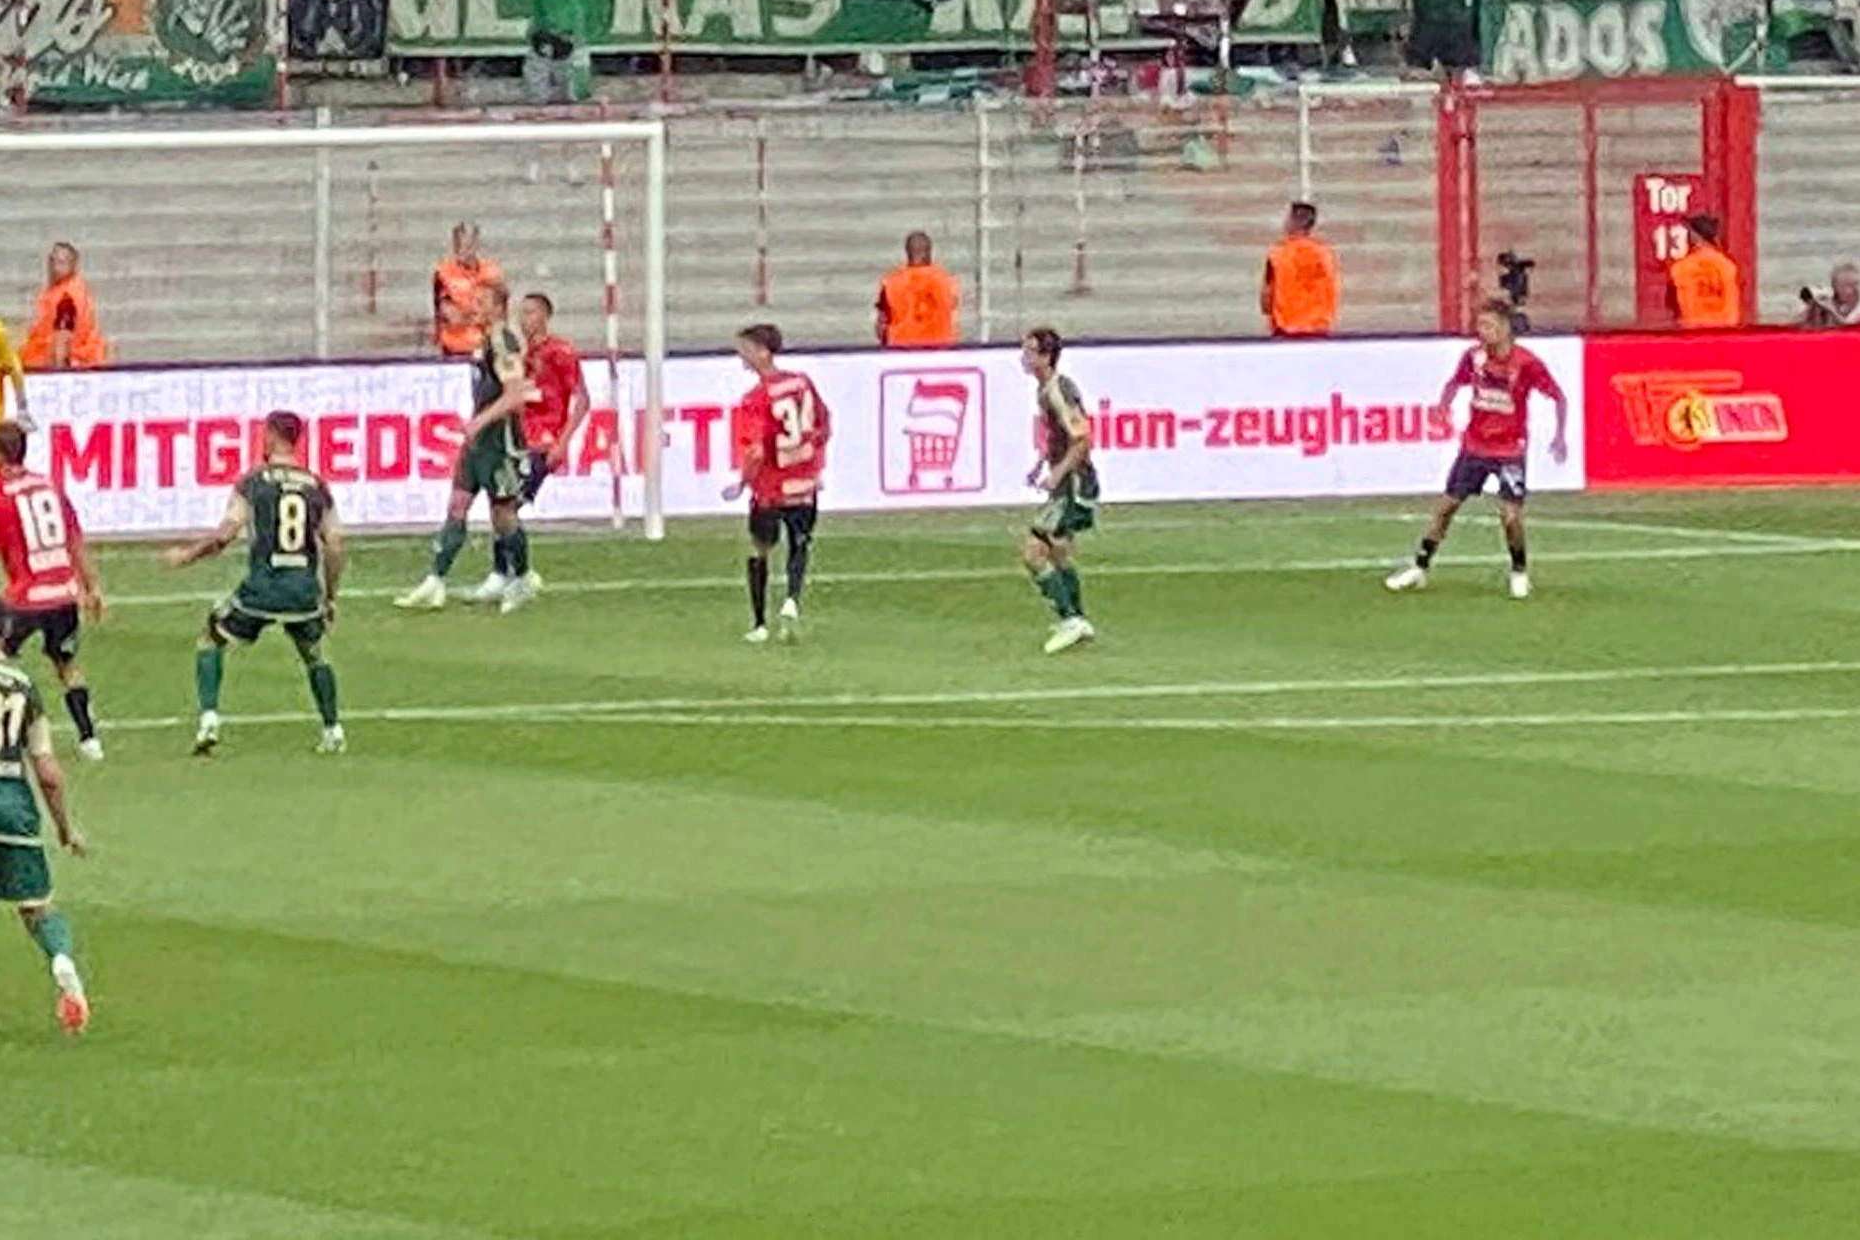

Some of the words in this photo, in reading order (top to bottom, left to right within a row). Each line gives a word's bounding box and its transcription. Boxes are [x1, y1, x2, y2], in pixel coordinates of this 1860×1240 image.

[1645, 178, 1692, 214] Tor
[1652, 224, 1689, 261] 13
[16, 490, 67, 552] 18
[279, 493, 307, 553] 8
